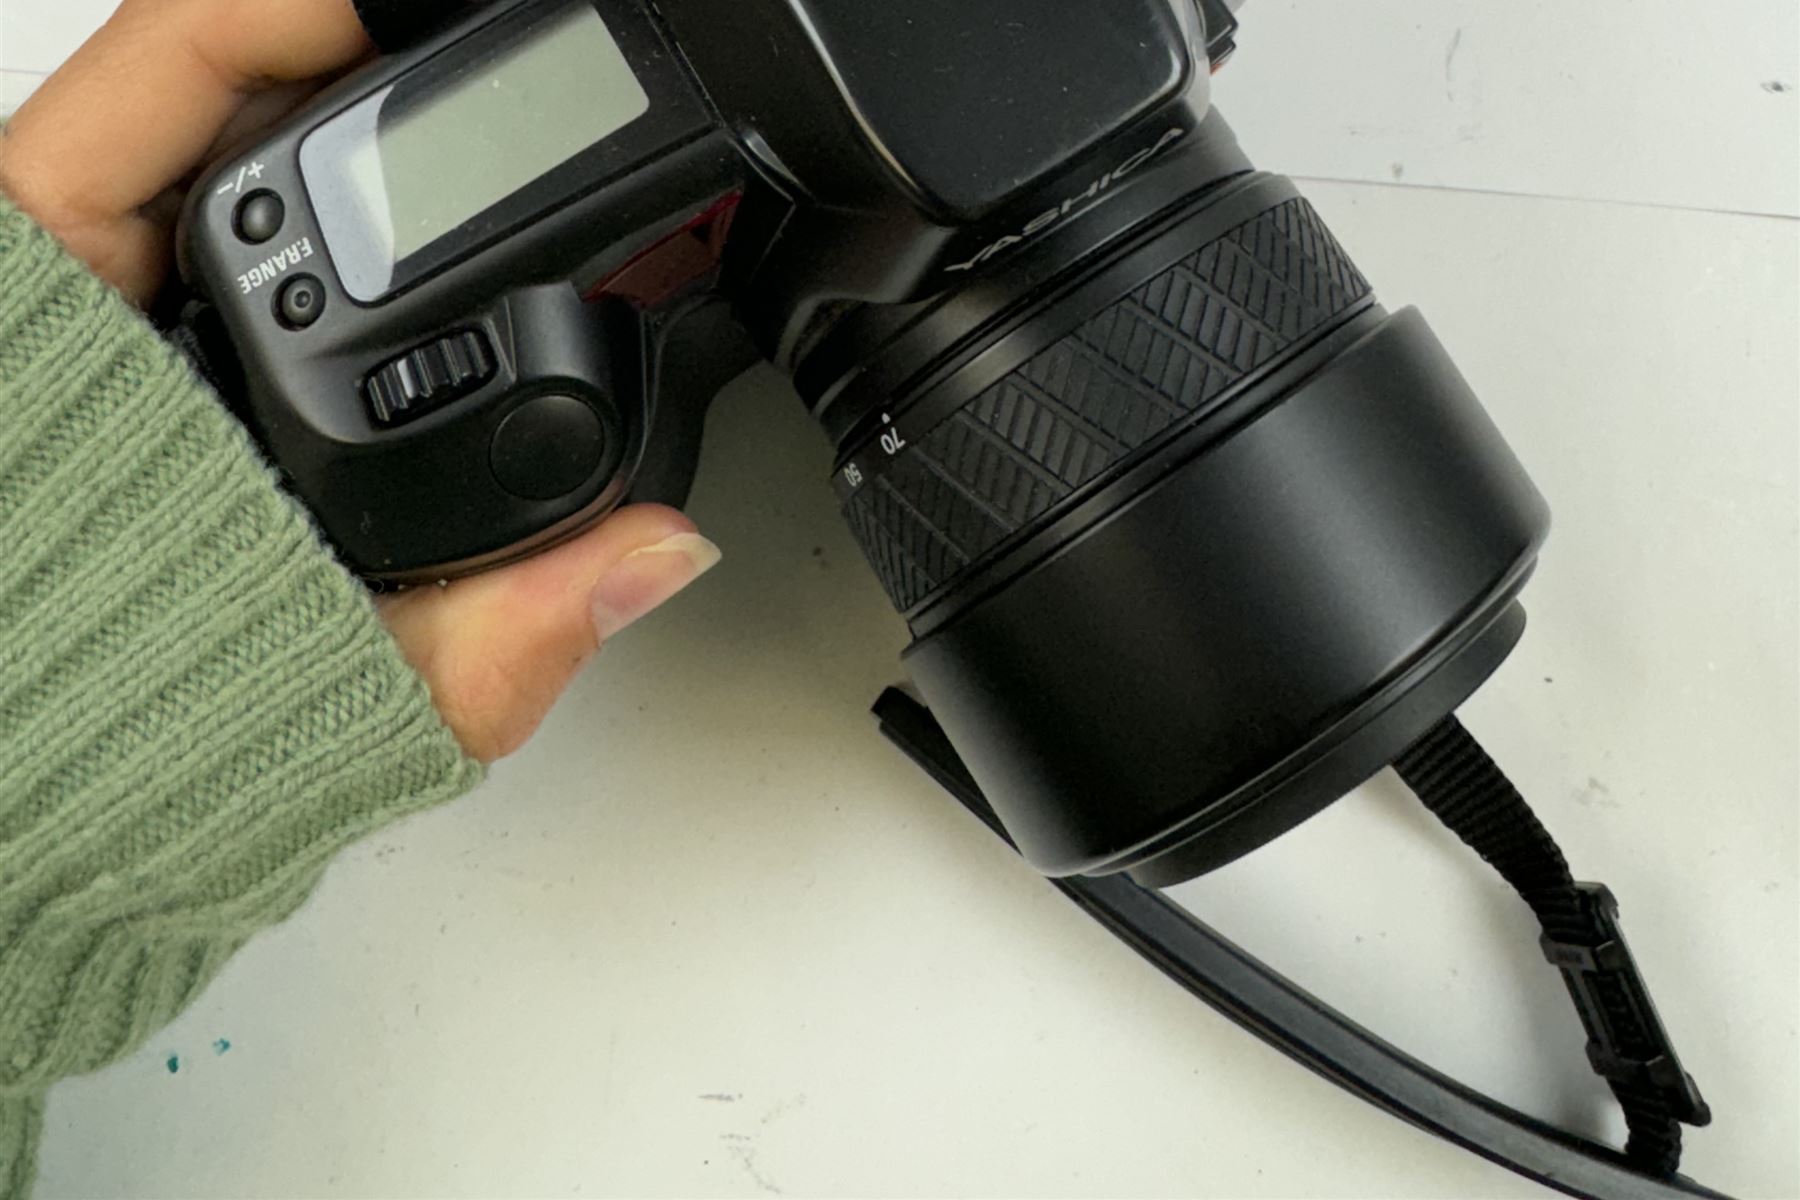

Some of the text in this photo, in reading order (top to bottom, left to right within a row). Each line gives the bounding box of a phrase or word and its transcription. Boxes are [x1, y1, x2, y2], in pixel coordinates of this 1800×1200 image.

[943, 128, 1184, 272] YASHICA
[237, 236, 314, 294] F.RANGE
[880, 426, 906, 455] 70
